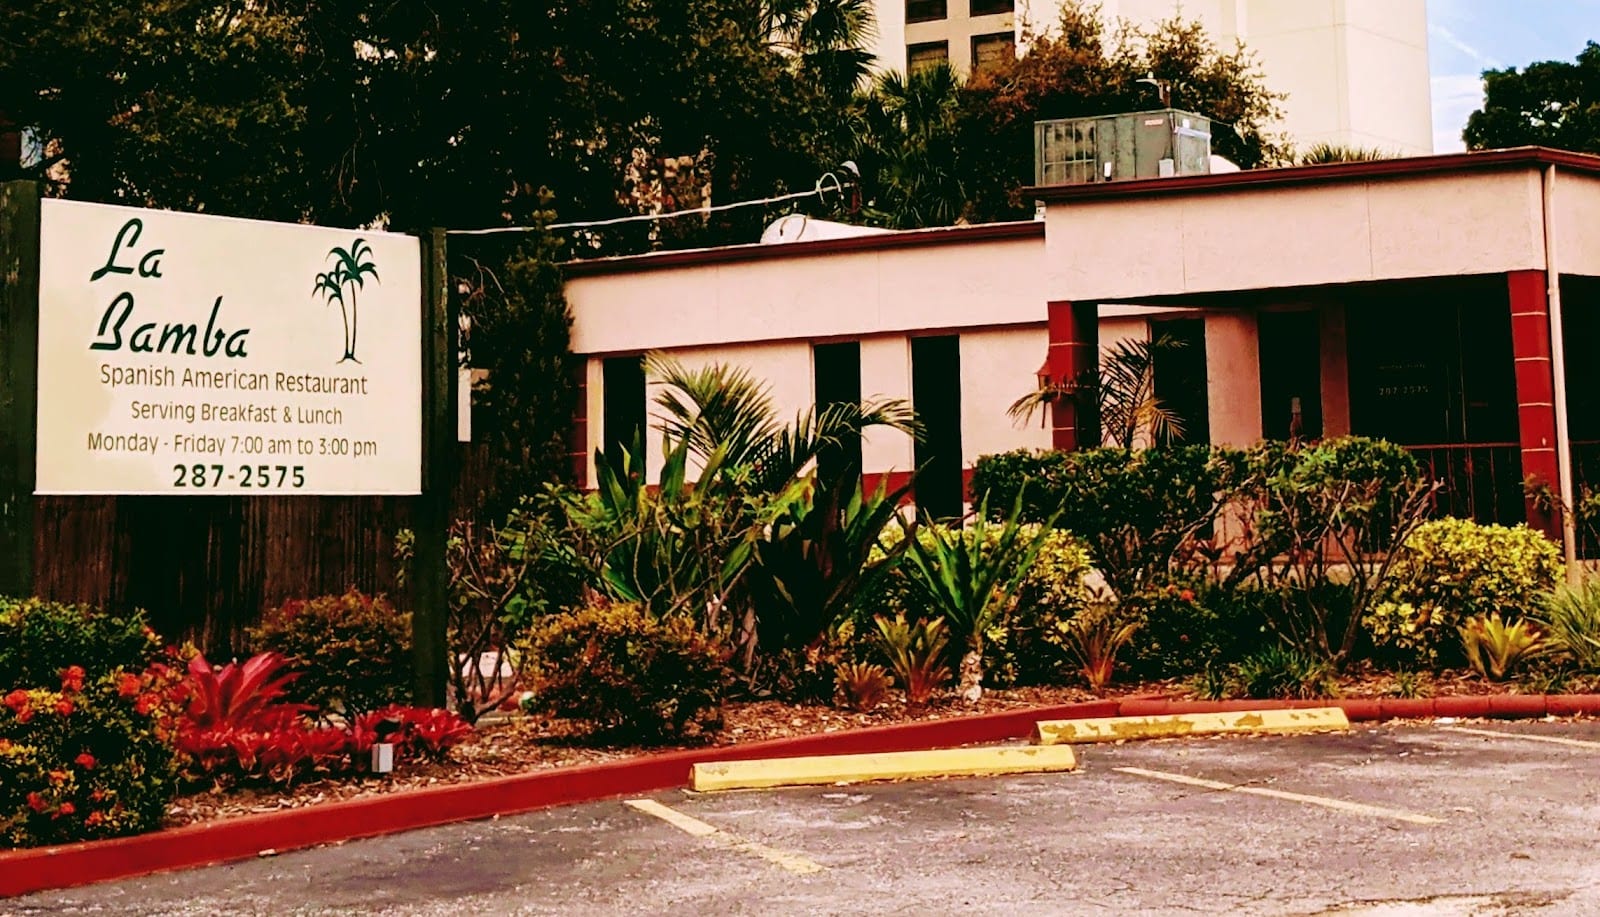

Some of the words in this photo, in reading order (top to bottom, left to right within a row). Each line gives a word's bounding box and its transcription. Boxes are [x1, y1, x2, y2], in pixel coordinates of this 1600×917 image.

[89, 218, 165, 282] La
[89, 291, 250, 358] Bamba
[100, 364, 175, 389] Spanish
[182, 368, 269, 391] American
[275, 372, 368, 396] Restaurant
[131, 401, 195, 424] Serving
[201, 402, 277, 424] Breakfast
[283, 406, 293, 424] &
[298, 406, 343, 425] Lunch
[88, 433, 159, 455] Monday
[174, 434, 226, 457] Friday
[231, 436, 264, 455] 7:00
[267, 439, 292, 455] am
[297, 437, 314, 455] to
[319, 438, 349, 456] 3:00
[353, 441, 377, 459] pm
[173, 464, 305, 488] 287-2575
